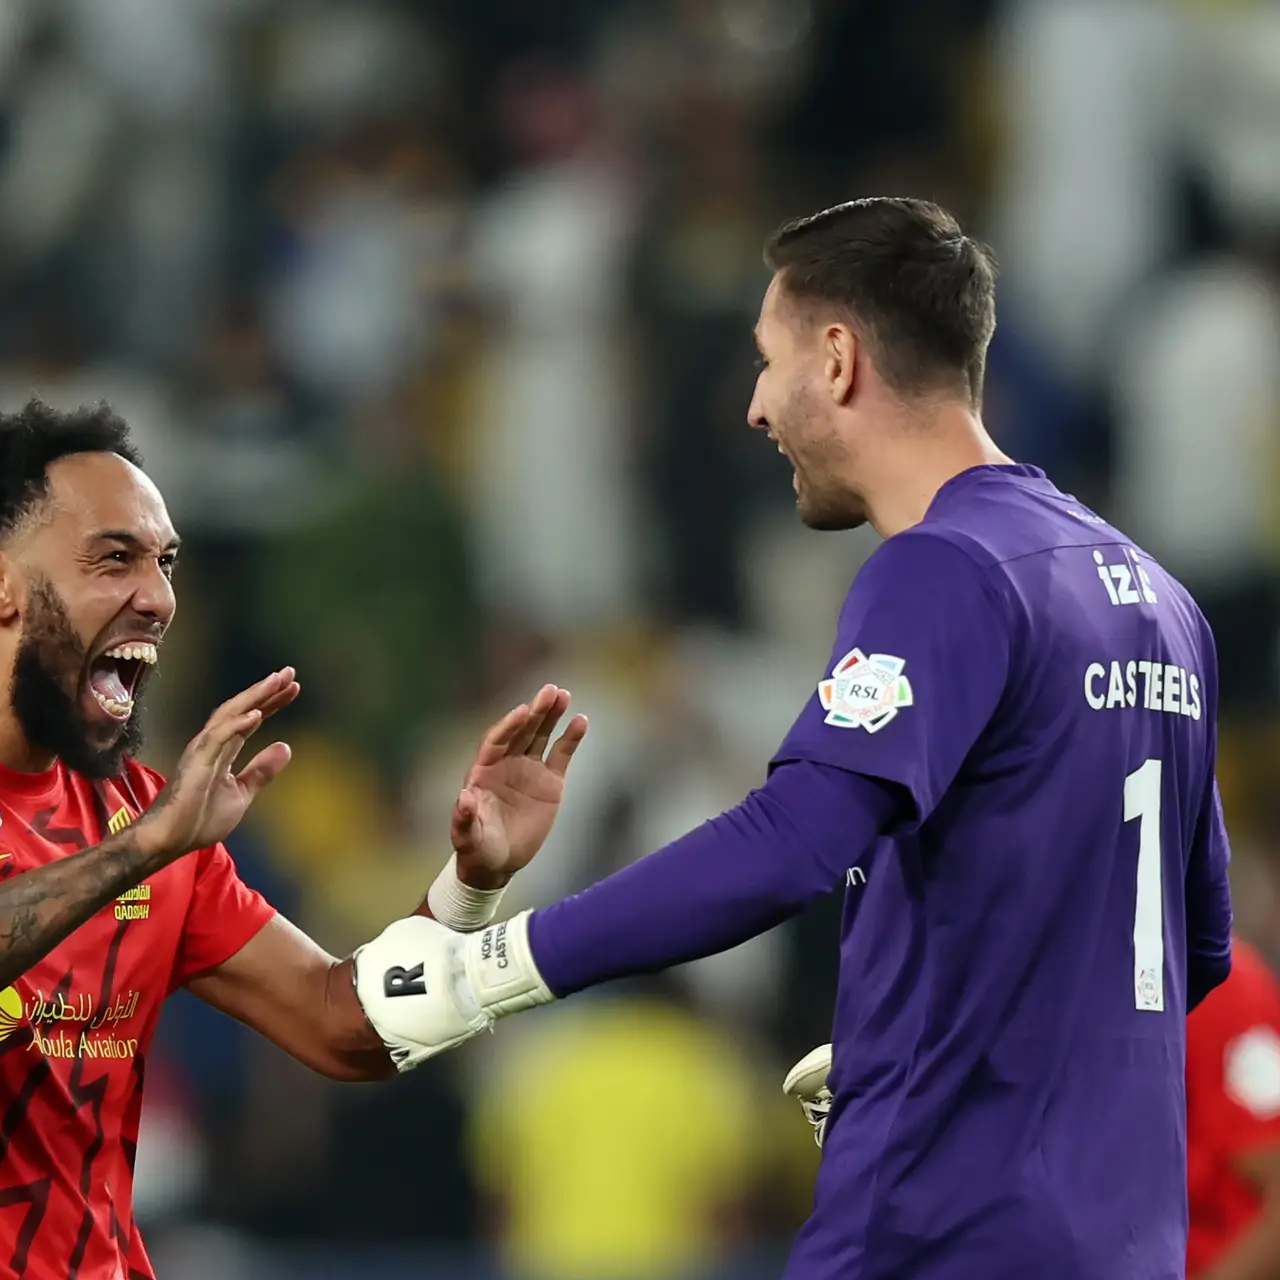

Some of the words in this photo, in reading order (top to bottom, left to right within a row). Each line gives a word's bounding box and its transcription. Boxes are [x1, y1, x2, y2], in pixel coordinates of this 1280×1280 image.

[849, 684, 879, 701] RSL
[1084, 659, 1201, 721] CASTEELS
[1123, 759, 1164, 1012] 1
[481, 929, 493, 960] KOEN
[383, 961, 427, 998] R
[25, 989, 93, 1026] للطيران
[26, 1028, 75, 1058] Aoula
[78, 1031, 138, 1059] Aviation
